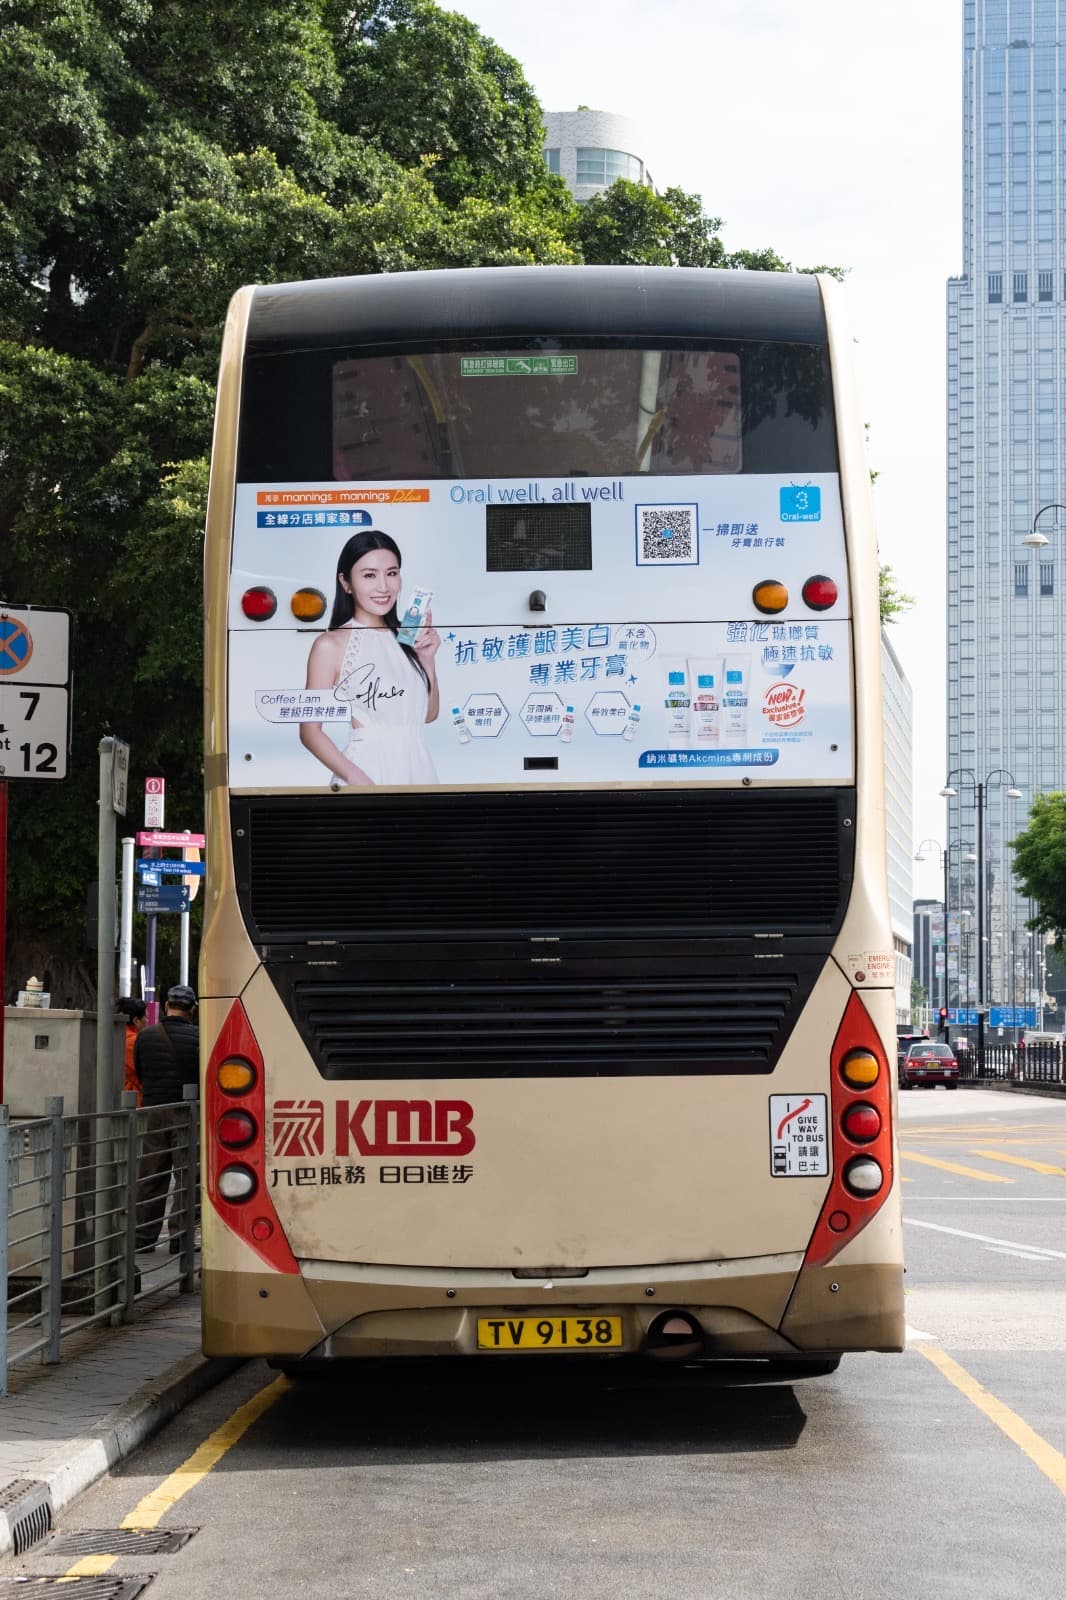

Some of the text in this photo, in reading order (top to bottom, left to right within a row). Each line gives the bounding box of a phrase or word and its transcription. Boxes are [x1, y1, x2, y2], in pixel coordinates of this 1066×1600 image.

[282, 491, 333, 503] mannings
[339, 490, 390, 503] mannings
[450, 481, 624, 504] Oral well, all well
[264, 512, 363, 526] 全線分店獨家發售
[781, 511, 820, 521] Oral-well
[703, 523, 759, 537] 一掃即送
[731, 537, 785, 548] 牙膏旅行裝
[626, 627, 646, 639] 不含
[454, 624, 611, 665] 抗敏護齦美白
[763, 644, 833, 661] 極速抗敏
[529, 653, 628, 685] 專業牙膏
[19, 691, 41, 721] 7
[260, 694, 321, 705] Coffee Lam
[20, 742, 58, 773] 12
[797, 1116, 818, 1124] GIVE
[335, 1099, 476, 1157] KMB
[798, 1125, 818, 1133] WAY
[792, 1134, 824, 1142] TO BUS
[798, 1160, 820, 1171] 巴士
[271, 1165, 474, 1187] 九巴服務 日日進步
[487, 1319, 613, 1346] TV 9138
